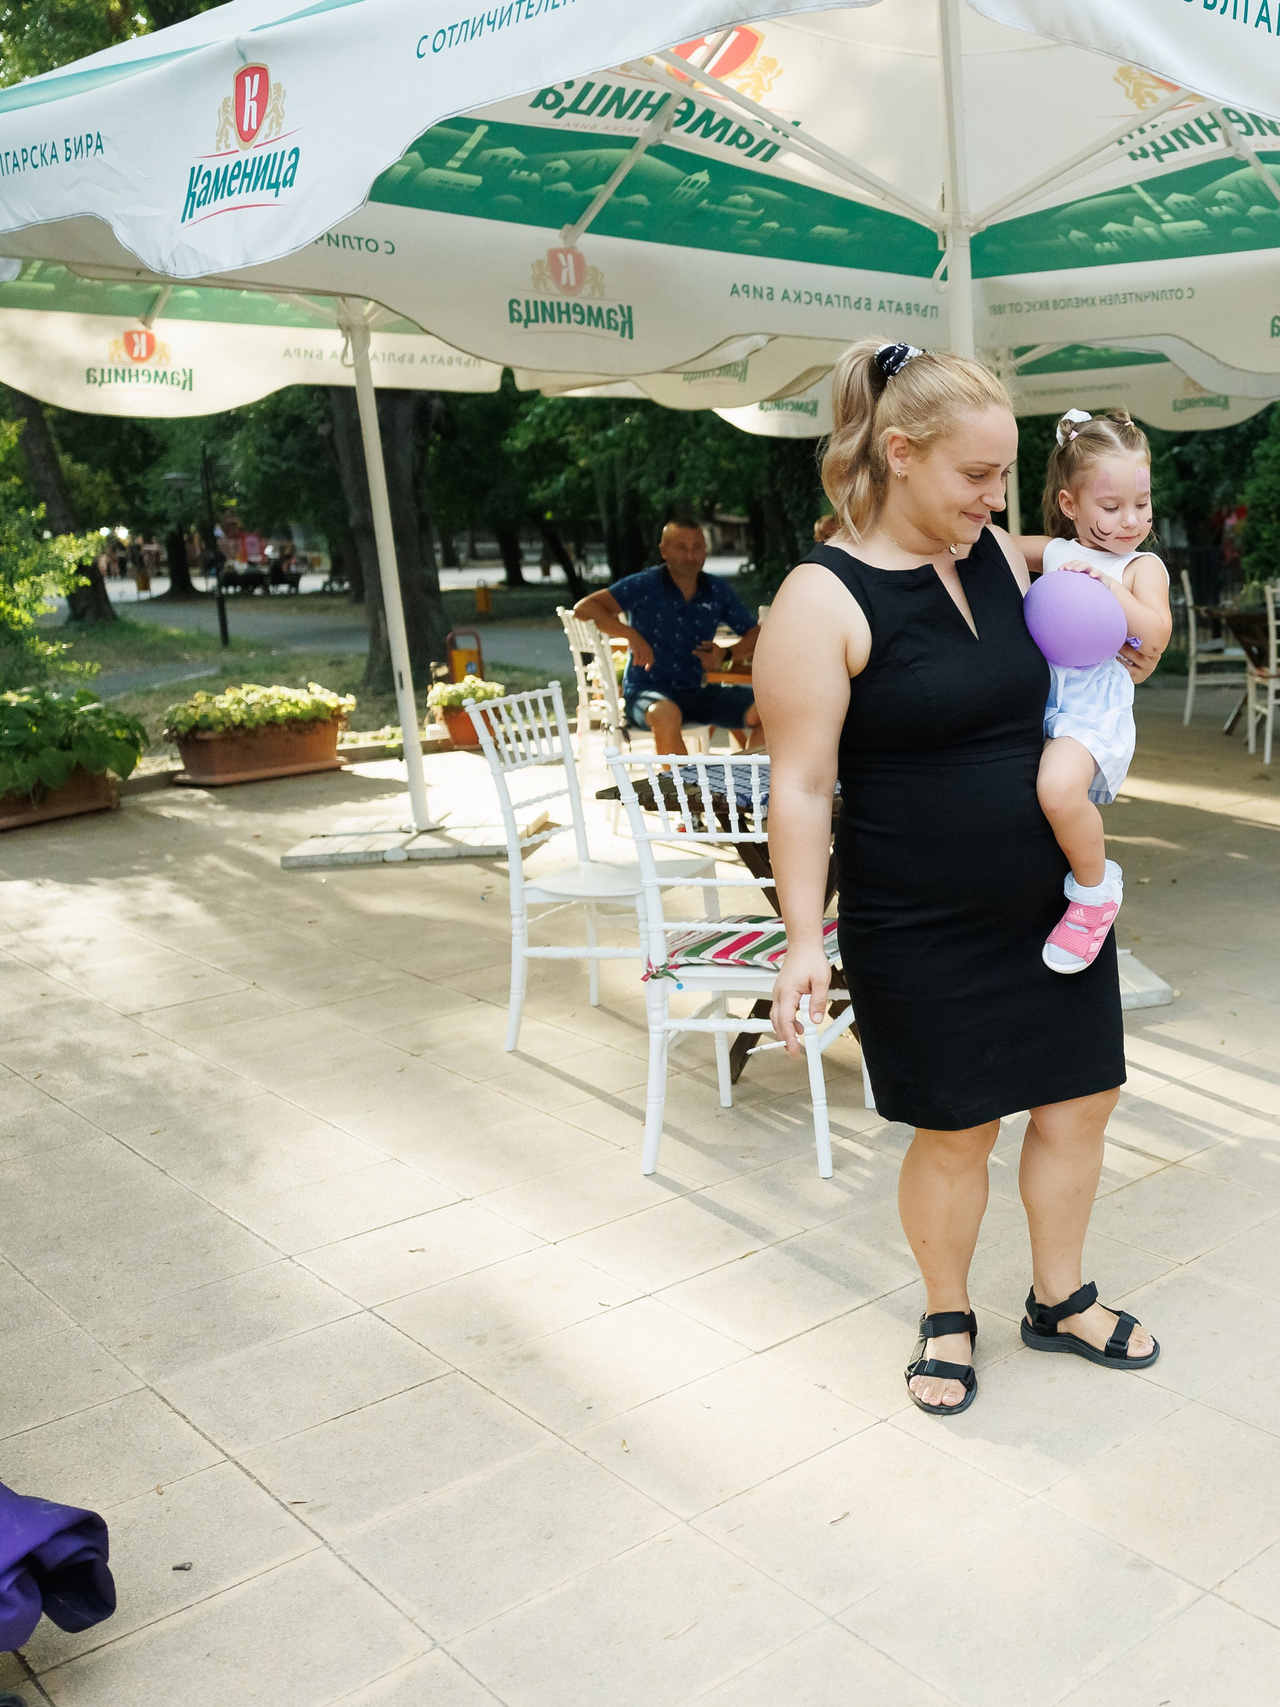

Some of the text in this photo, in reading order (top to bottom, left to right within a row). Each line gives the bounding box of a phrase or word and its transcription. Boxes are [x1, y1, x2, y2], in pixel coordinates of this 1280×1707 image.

[432, 0, 576, 53] ОТЛИЧИТЕЛ
[64, 130, 104, 163] БИРА
[180, 146, 301, 224] Каменица
